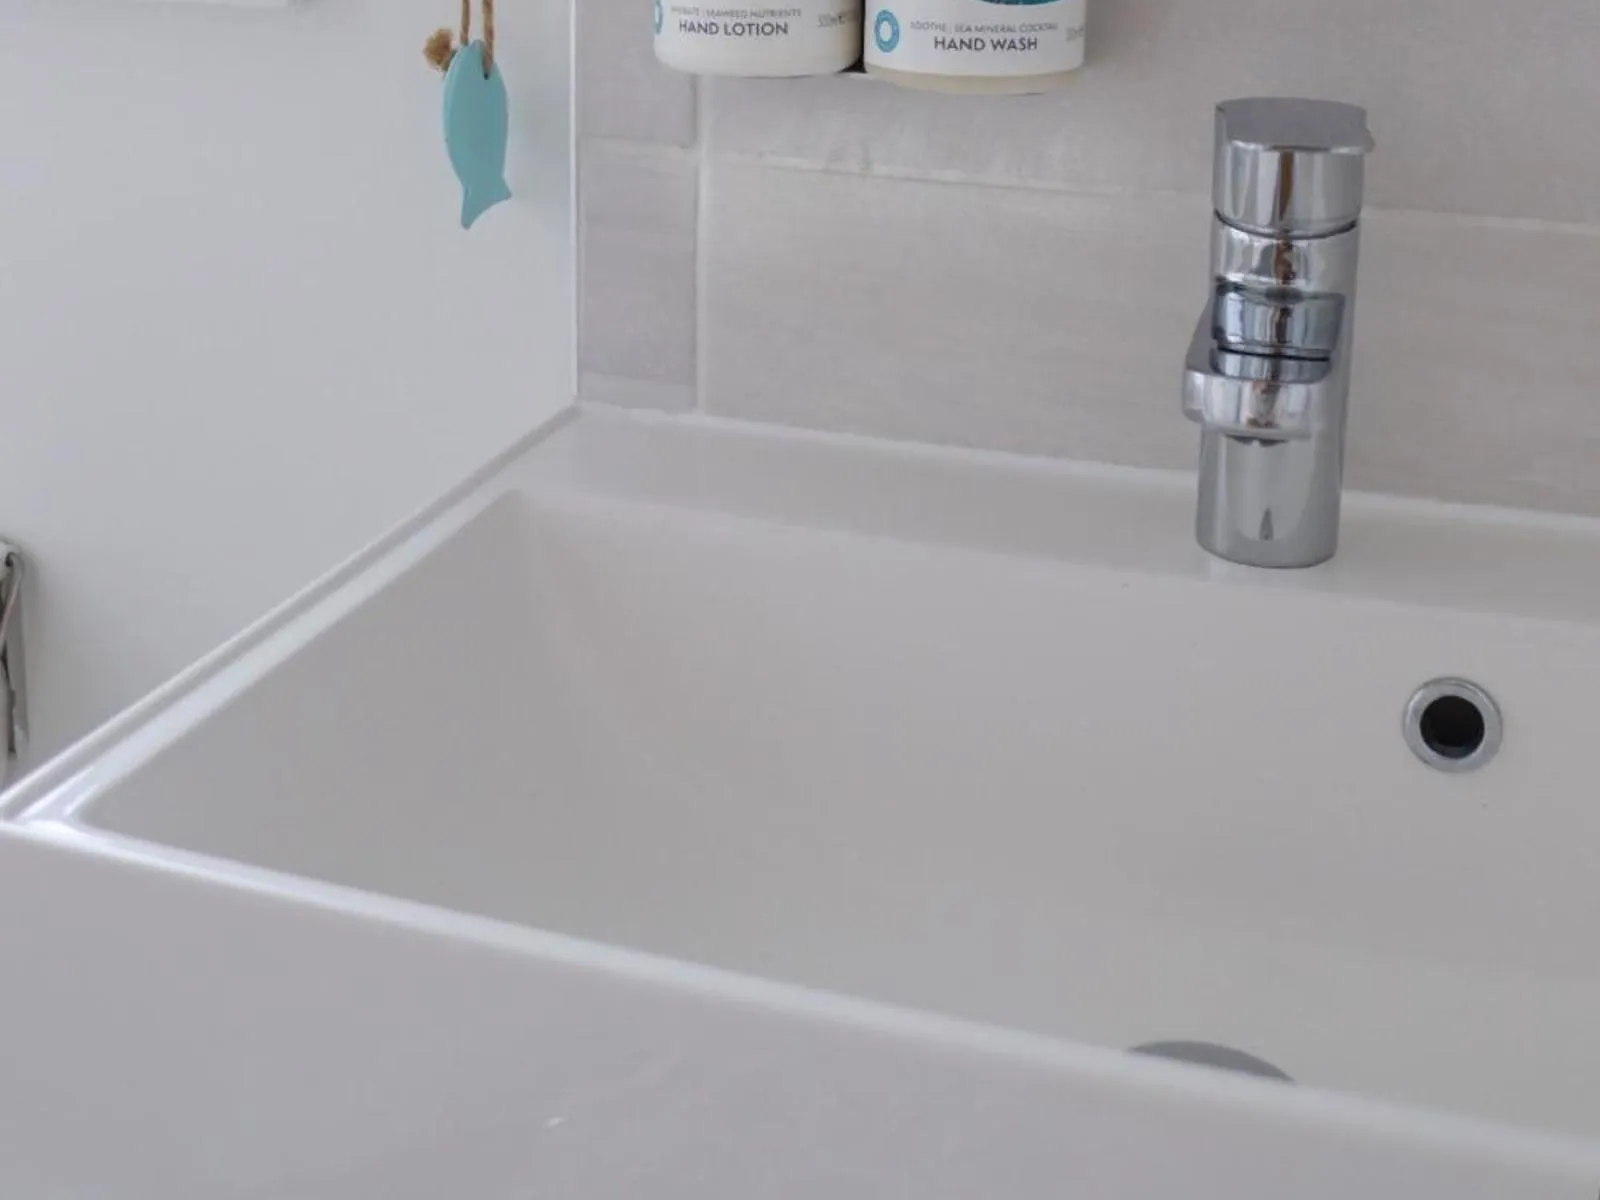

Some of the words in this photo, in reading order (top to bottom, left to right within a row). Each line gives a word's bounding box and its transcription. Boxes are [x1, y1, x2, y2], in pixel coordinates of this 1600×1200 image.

[678, 19, 720, 36] HAND
[723, 21, 789, 37] LOTION
[974, 22, 1017, 33] MINERAL
[933, 36, 986, 51] HAND
[989, 36, 1038, 51] WASH
